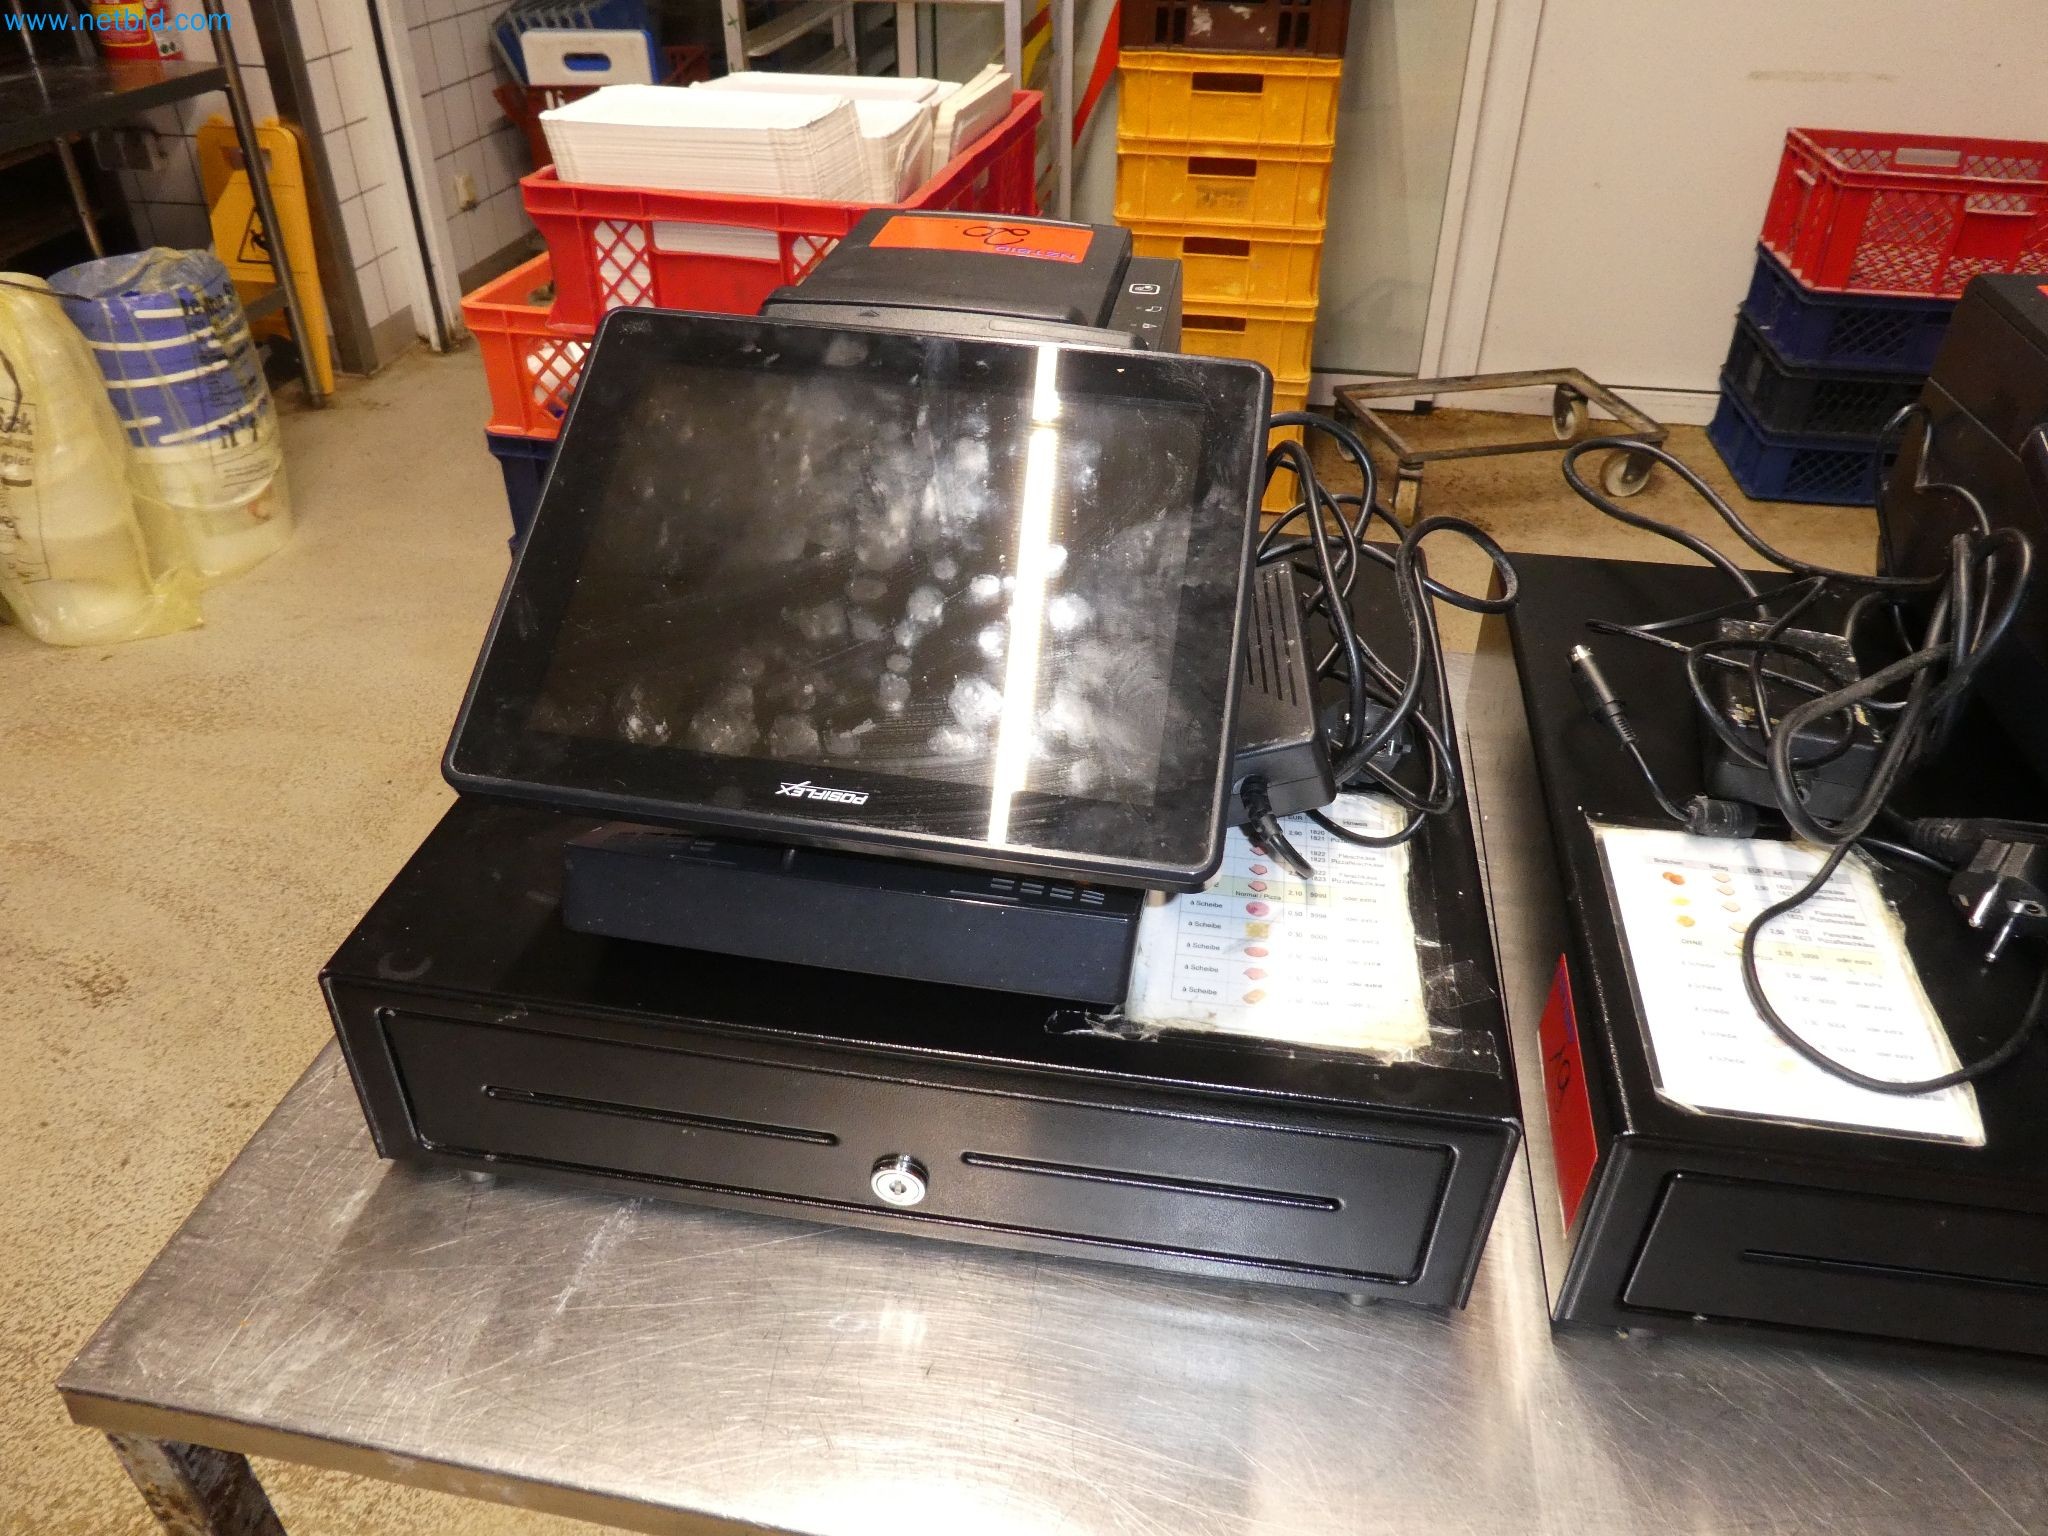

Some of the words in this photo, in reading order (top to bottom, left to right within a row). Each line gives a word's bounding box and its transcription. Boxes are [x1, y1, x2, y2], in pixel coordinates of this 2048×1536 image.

[775, 781, 869, 805] POSIFLEX
[1197, 900, 1223, 909] Scheibe
[1195, 921, 1222, 930] Scheibe
[1192, 942, 1220, 951] Scheibe
[1191, 964, 1219, 973] Scheibe
[1189, 986, 1217, 996] Scheibe
